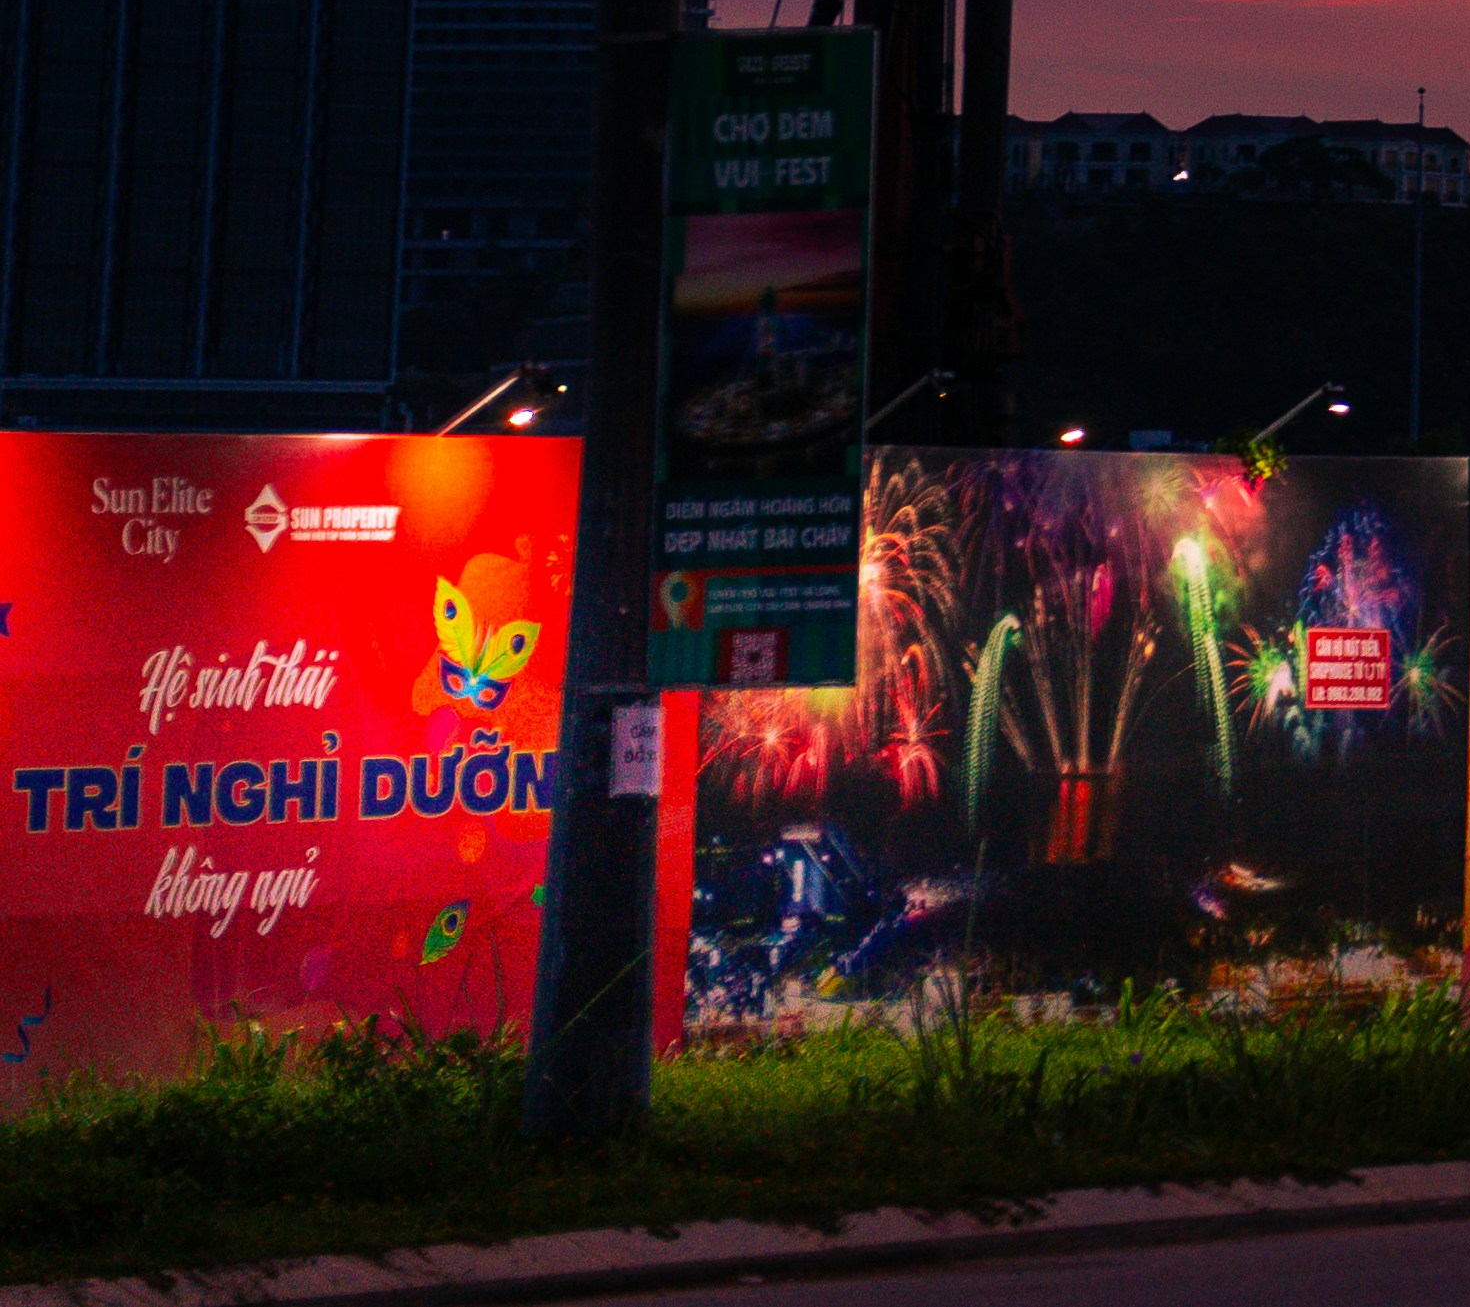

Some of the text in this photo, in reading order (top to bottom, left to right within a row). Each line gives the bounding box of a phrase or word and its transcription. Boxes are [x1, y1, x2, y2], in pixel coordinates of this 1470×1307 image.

[712, 112, 771, 147] CHỢ
[91, 476, 213, 514] Sun Elite
[290, 507, 319, 529] SUN
[323, 506, 399, 529] PROPERTY
[121, 519, 180, 564] City
[139, 638, 339, 734] Hệ sinh thái
[13, 745, 144, 832] TRÍ
[161, 730, 340, 828] NGHỈ
[358, 727, 558, 820] DƯỠN
[144, 845, 321, 938] không ngủ
